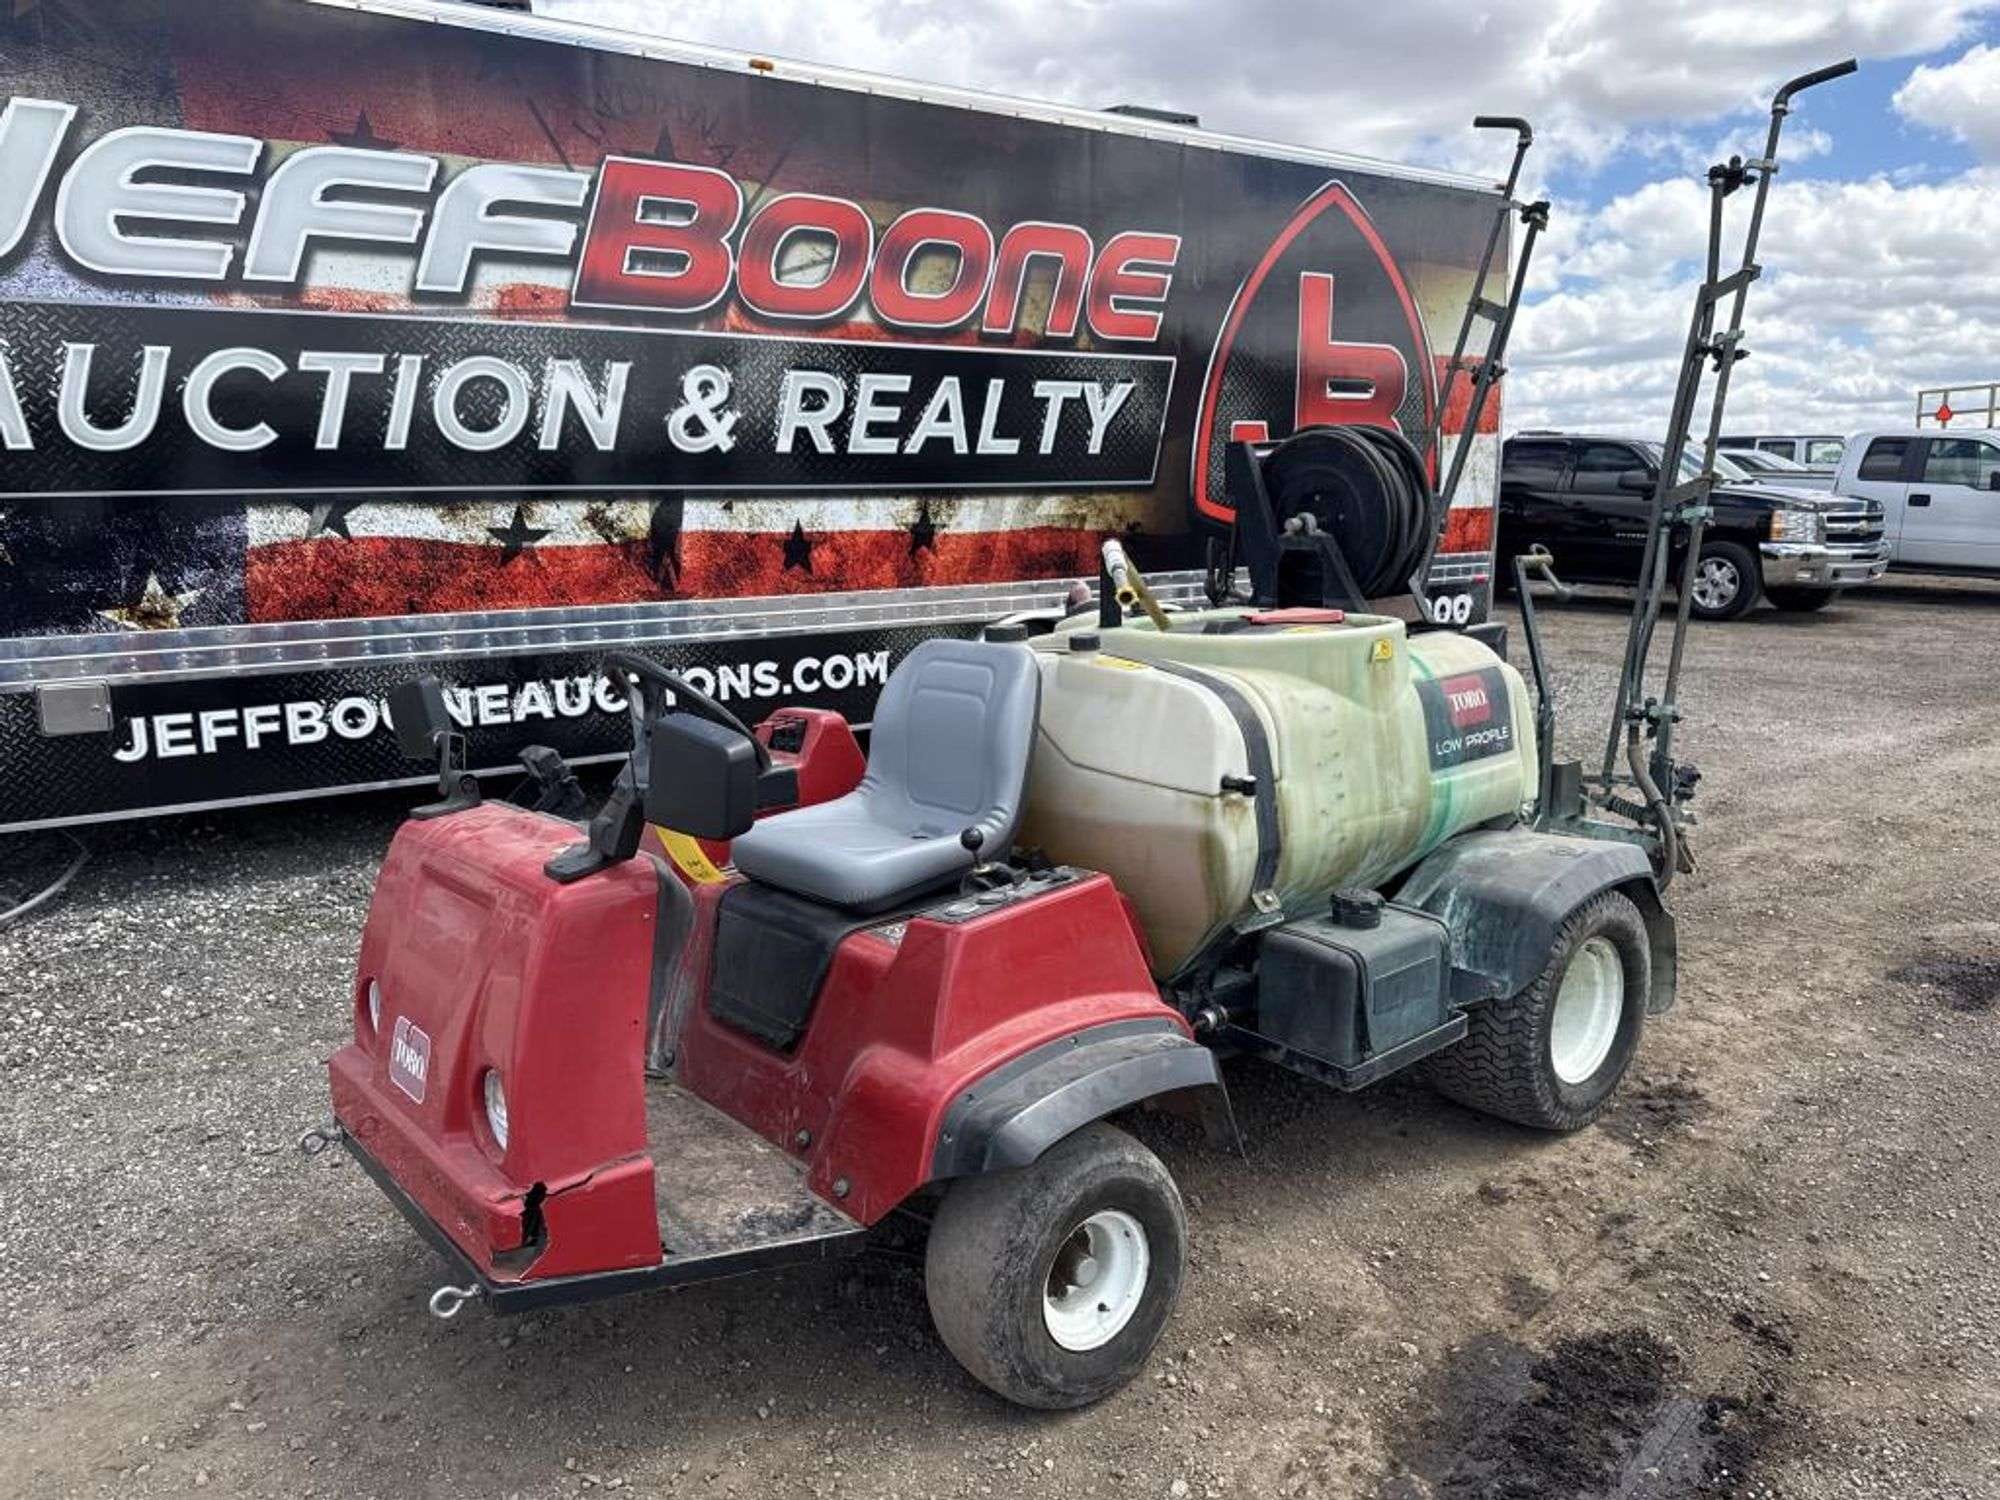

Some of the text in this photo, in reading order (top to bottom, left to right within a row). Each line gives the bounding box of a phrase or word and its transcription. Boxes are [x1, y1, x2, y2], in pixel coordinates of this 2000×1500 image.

[667, 365, 742, 453] &
[775, 369, 1136, 455] REALTY
[1451, 688, 1488, 712] TORO
[1435, 737, 1462, 756] LOW
